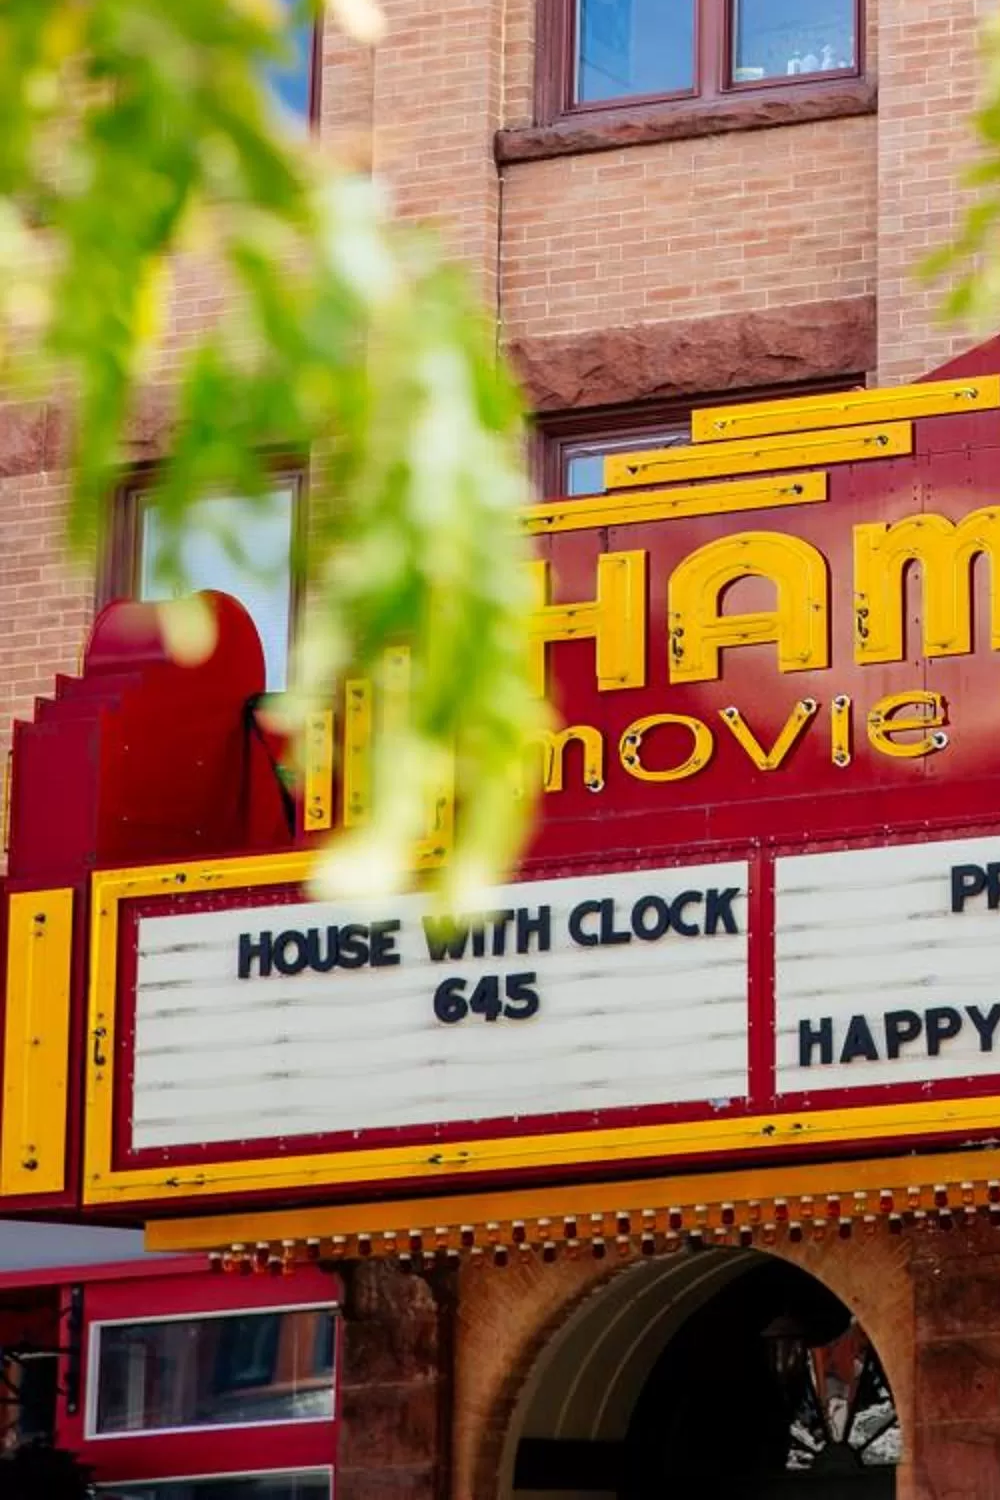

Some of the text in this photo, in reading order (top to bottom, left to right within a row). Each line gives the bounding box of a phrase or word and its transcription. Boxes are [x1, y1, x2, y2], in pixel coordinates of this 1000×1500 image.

[522, 689, 949, 793] MOVIE
[238, 887, 742, 980] HOUSE WITH CLOCK
[433, 971, 541, 1024] 645
